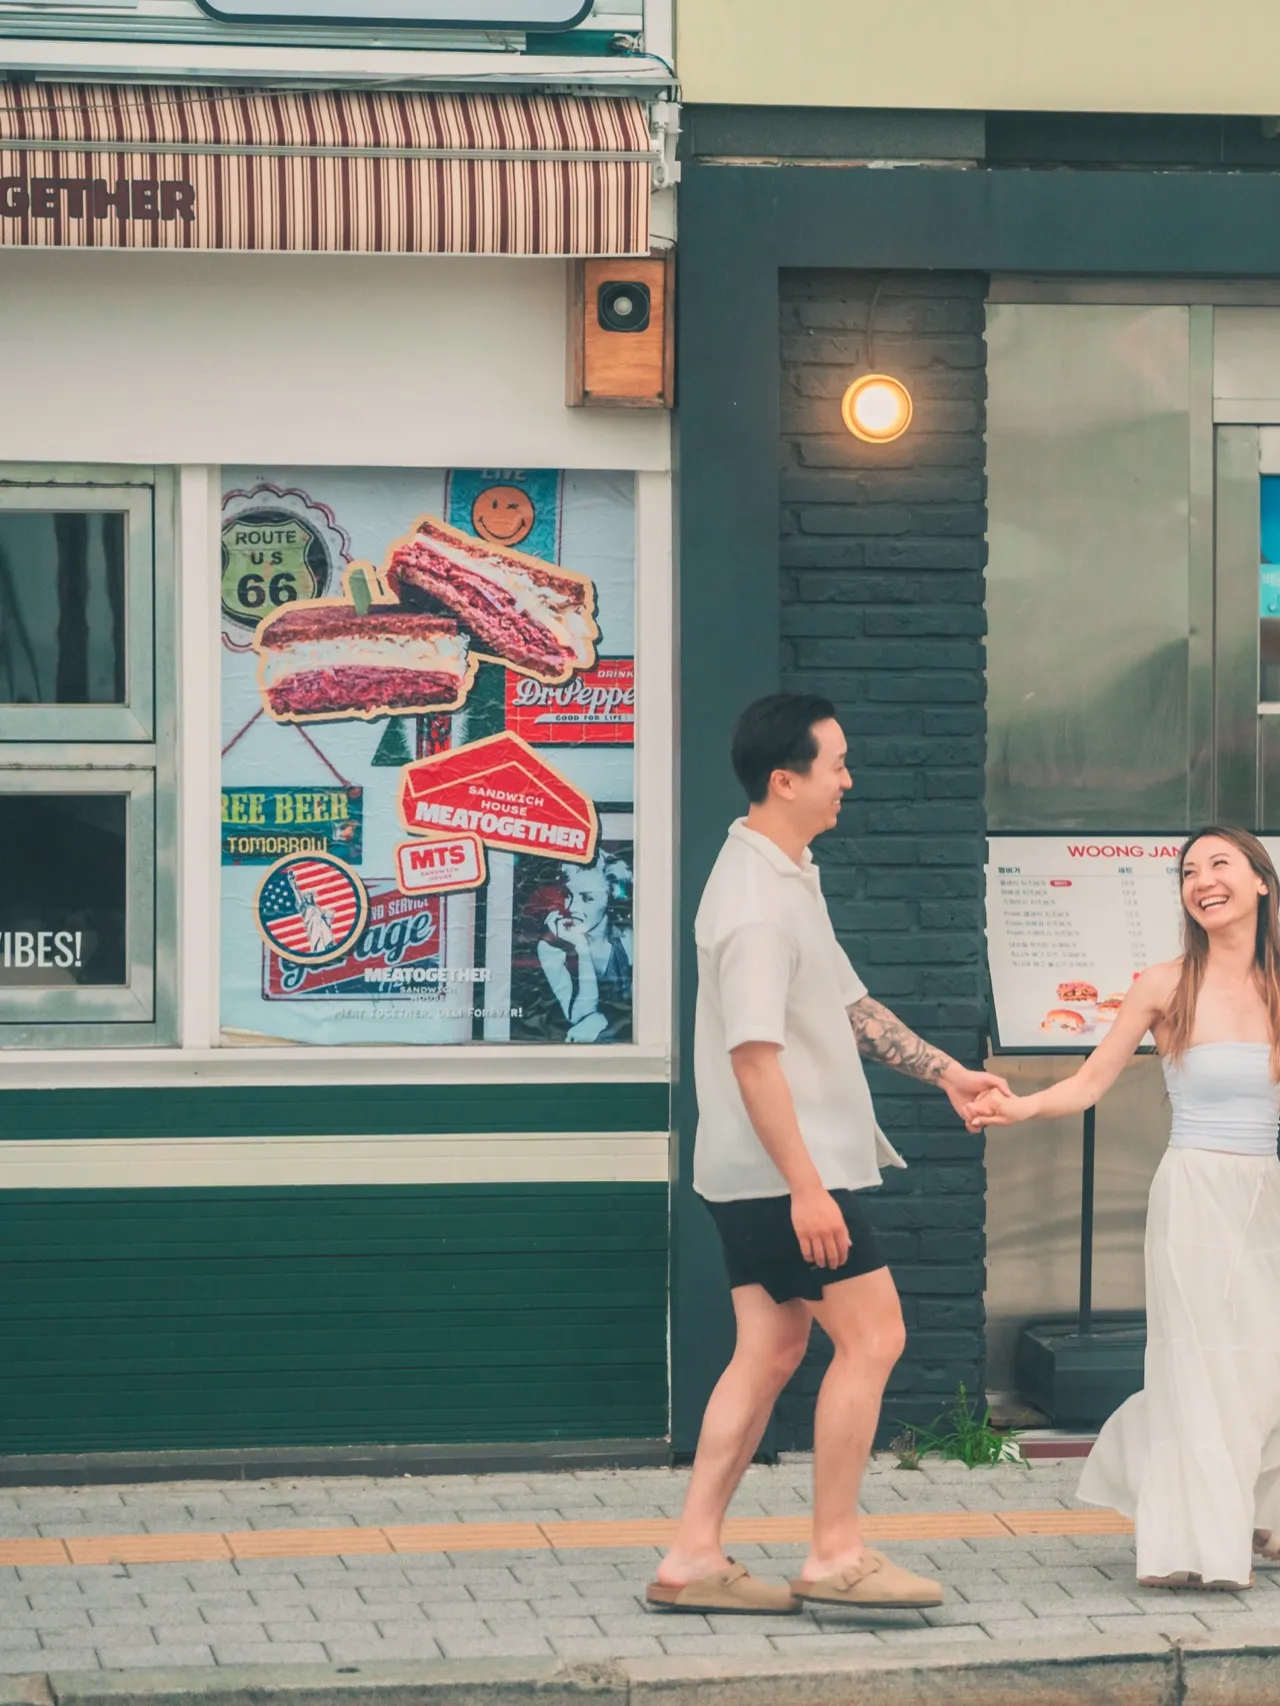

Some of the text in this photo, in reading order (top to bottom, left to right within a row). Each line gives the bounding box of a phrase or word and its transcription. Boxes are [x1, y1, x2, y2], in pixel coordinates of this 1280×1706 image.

[0, 175, 196, 222] GETHER
[235, 529, 297, 545] ROUTE
[236, 572, 298, 608] 66
[274, 793, 350, 825] BEER
[468, 785, 544, 808] SANDWICH
[480, 800, 527, 817] HOUSE
[415, 801, 587, 850] MEATOGETHER
[226, 836, 328, 854] TOMORROW
[410, 844, 466, 871] MTS
[1067, 845, 1144, 858] WOONG
[0, 931, 82, 968] IBES!
[364, 967, 493, 983] MEATOGETHER
